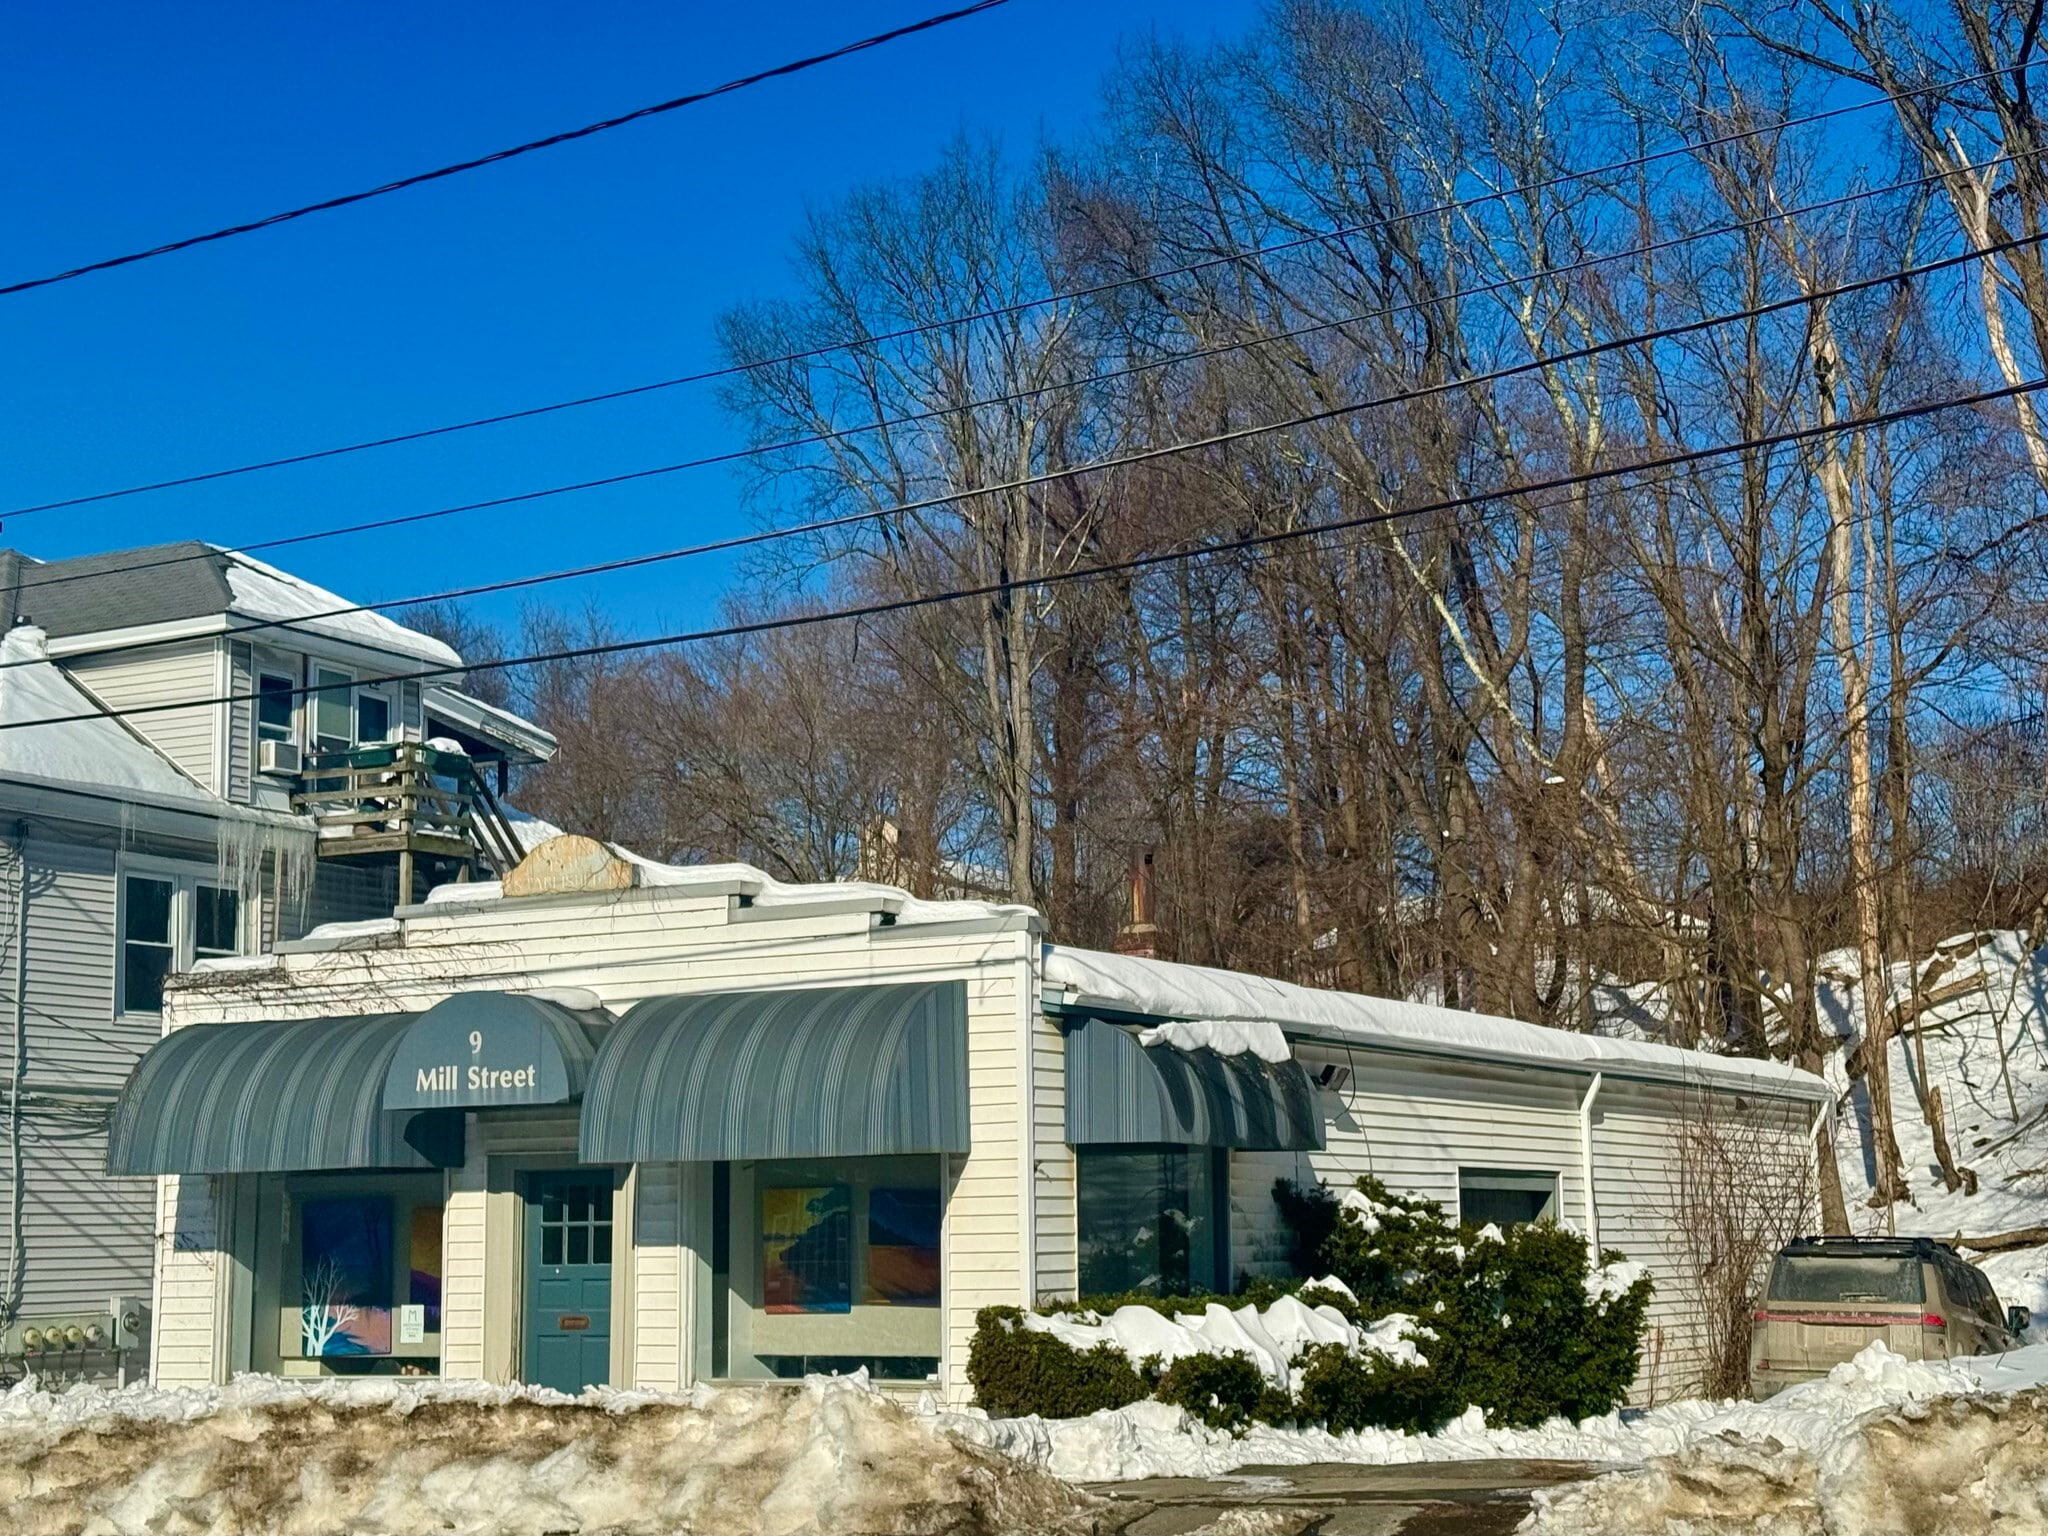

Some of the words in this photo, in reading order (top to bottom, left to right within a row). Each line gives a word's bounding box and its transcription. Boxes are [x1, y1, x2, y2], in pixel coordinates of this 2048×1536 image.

[468, 1030, 483, 1054] 9
[415, 1065, 458, 1092] Mill
[467, 1064, 536, 1090] Street
